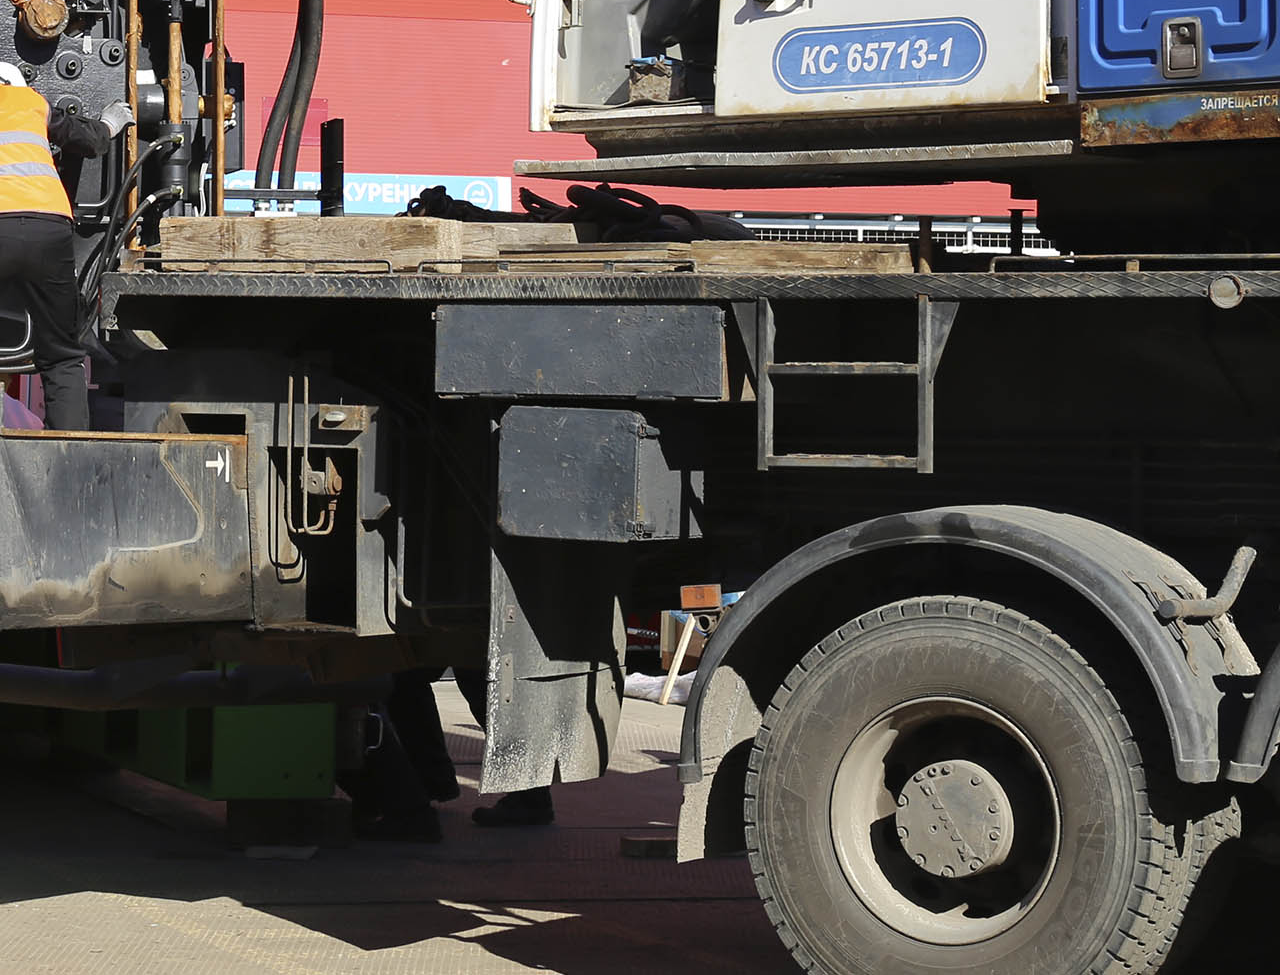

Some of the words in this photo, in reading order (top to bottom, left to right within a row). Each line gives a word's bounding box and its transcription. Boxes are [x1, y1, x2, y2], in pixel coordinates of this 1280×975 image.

[800, 45, 838, 75] КС
[847, 37, 954, 74] 65713-1
[1200, 94, 1279, 111] ЗАПРЕЩАЕТСЯ
